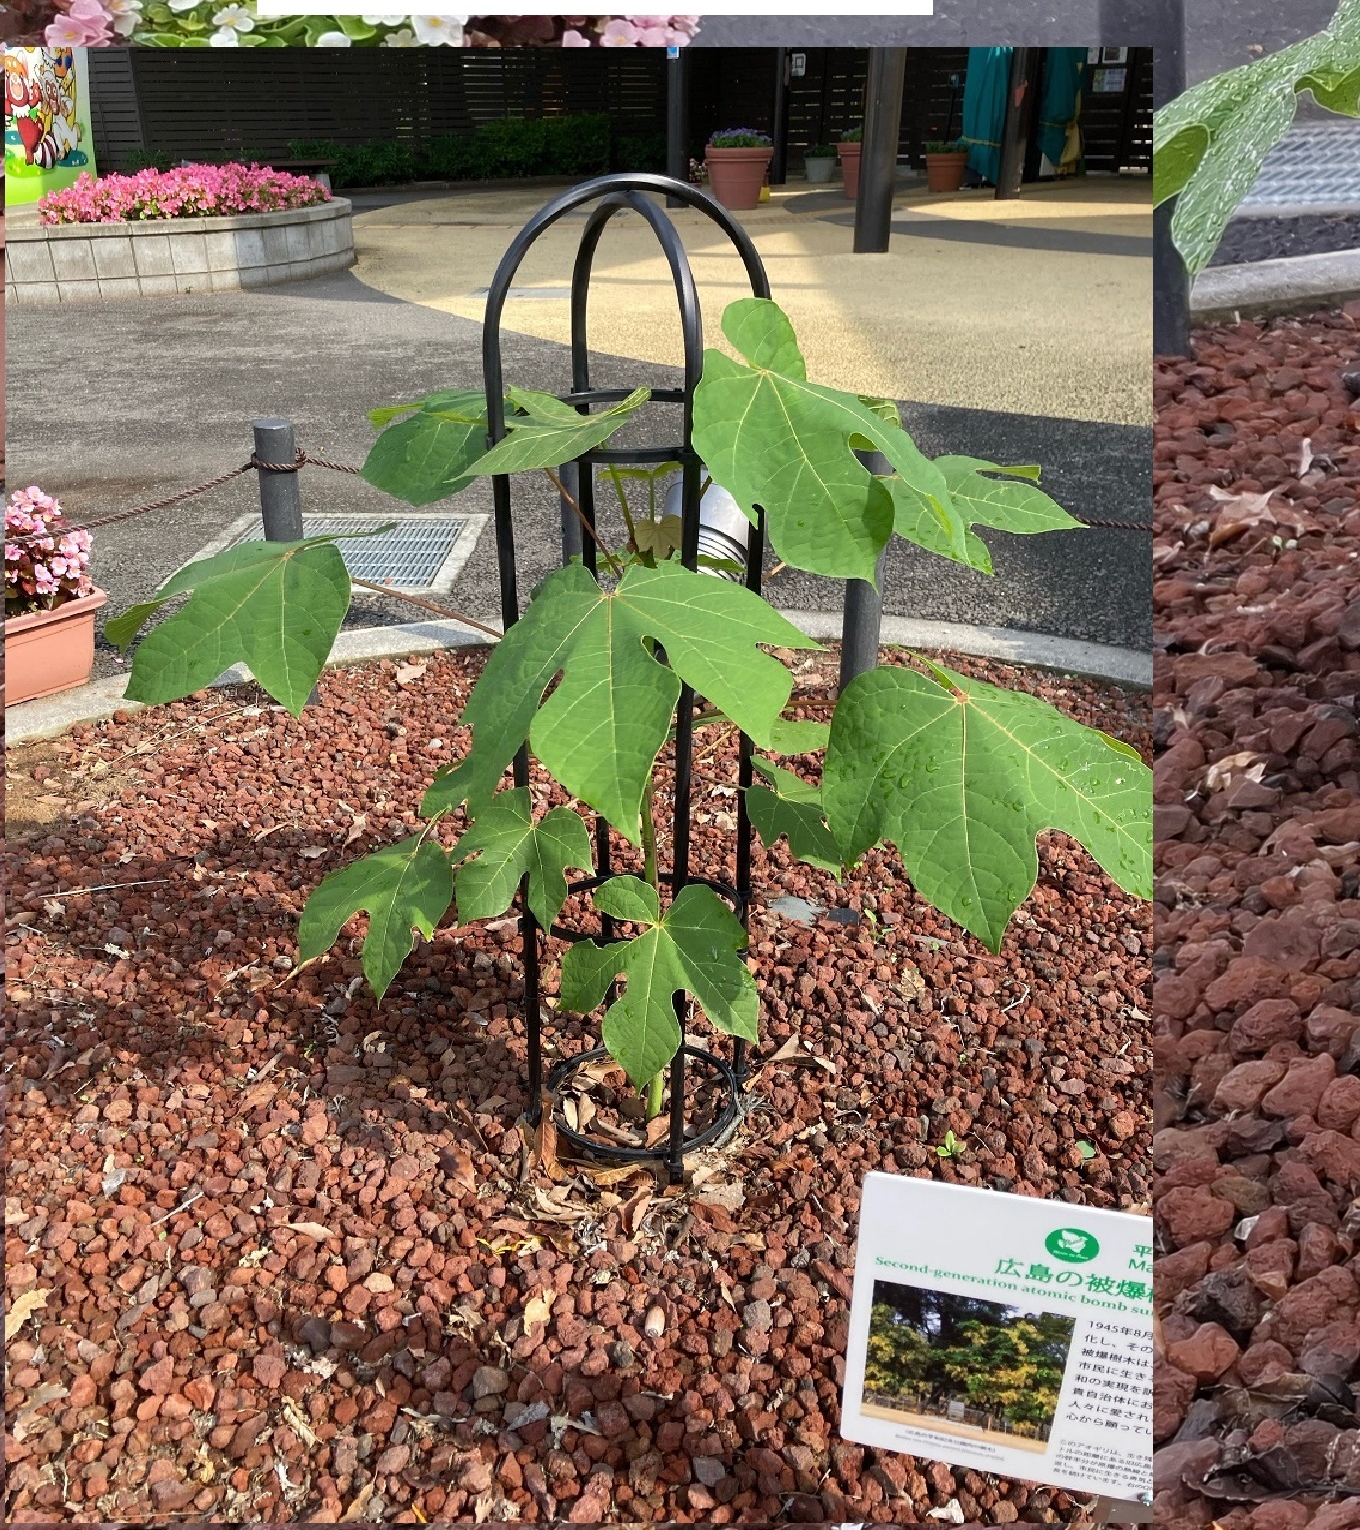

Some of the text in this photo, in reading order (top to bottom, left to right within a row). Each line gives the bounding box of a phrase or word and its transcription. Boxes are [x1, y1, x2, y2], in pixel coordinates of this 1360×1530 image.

[875, 1256, 1018, 1292] Second-generation
[1021, 1283, 1076, 1303] atomic
[1080, 1293, 1129, 1312] bomb
[995, 1258, 1153, 1305] 広島の被爆
[1079, 1361, 1153, 1382] 市民に生き
